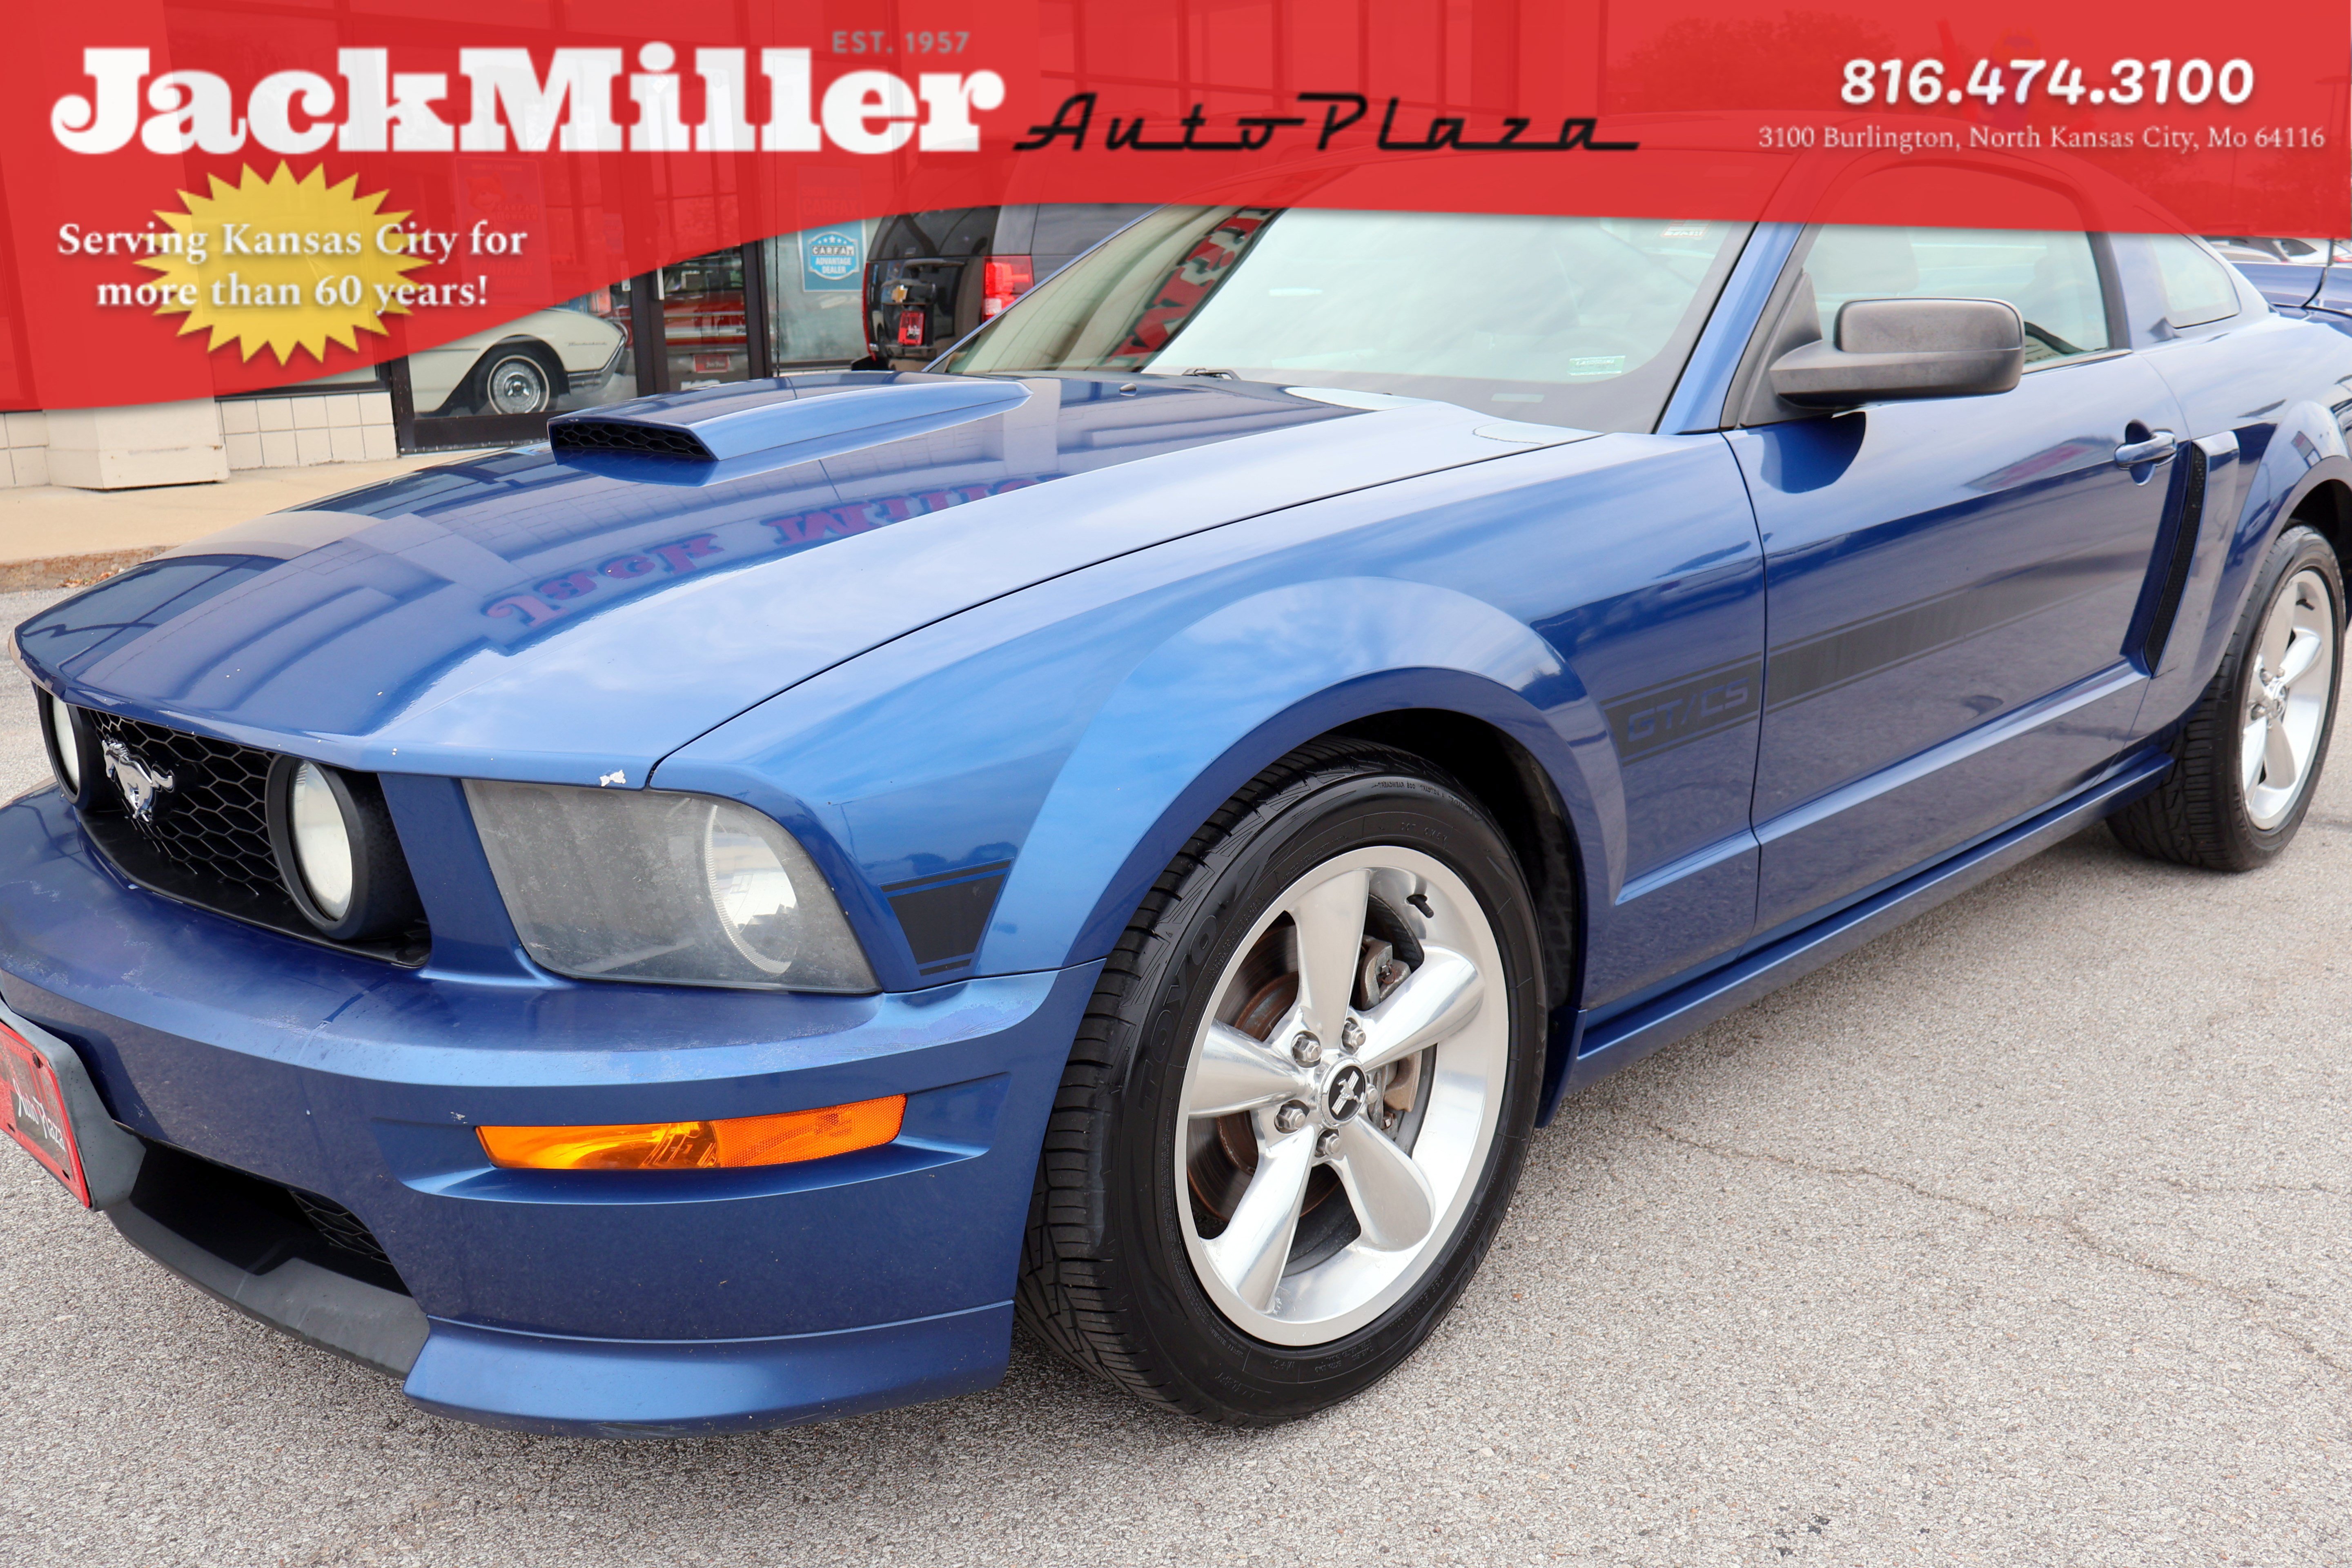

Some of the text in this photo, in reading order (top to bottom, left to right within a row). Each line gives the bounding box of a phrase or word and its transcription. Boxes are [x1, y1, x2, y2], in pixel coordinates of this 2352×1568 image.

[812, 245, 855, 256] CARFAX
[815, 256, 852, 265] ADVANTAGE
[821, 265, 846, 274] DEALER
[1627, 677, 1749, 743] GT/CS
[1138, 914, 1220, 1111] TOYO
[13, 1077, 67, 1153] Auto Plaza
